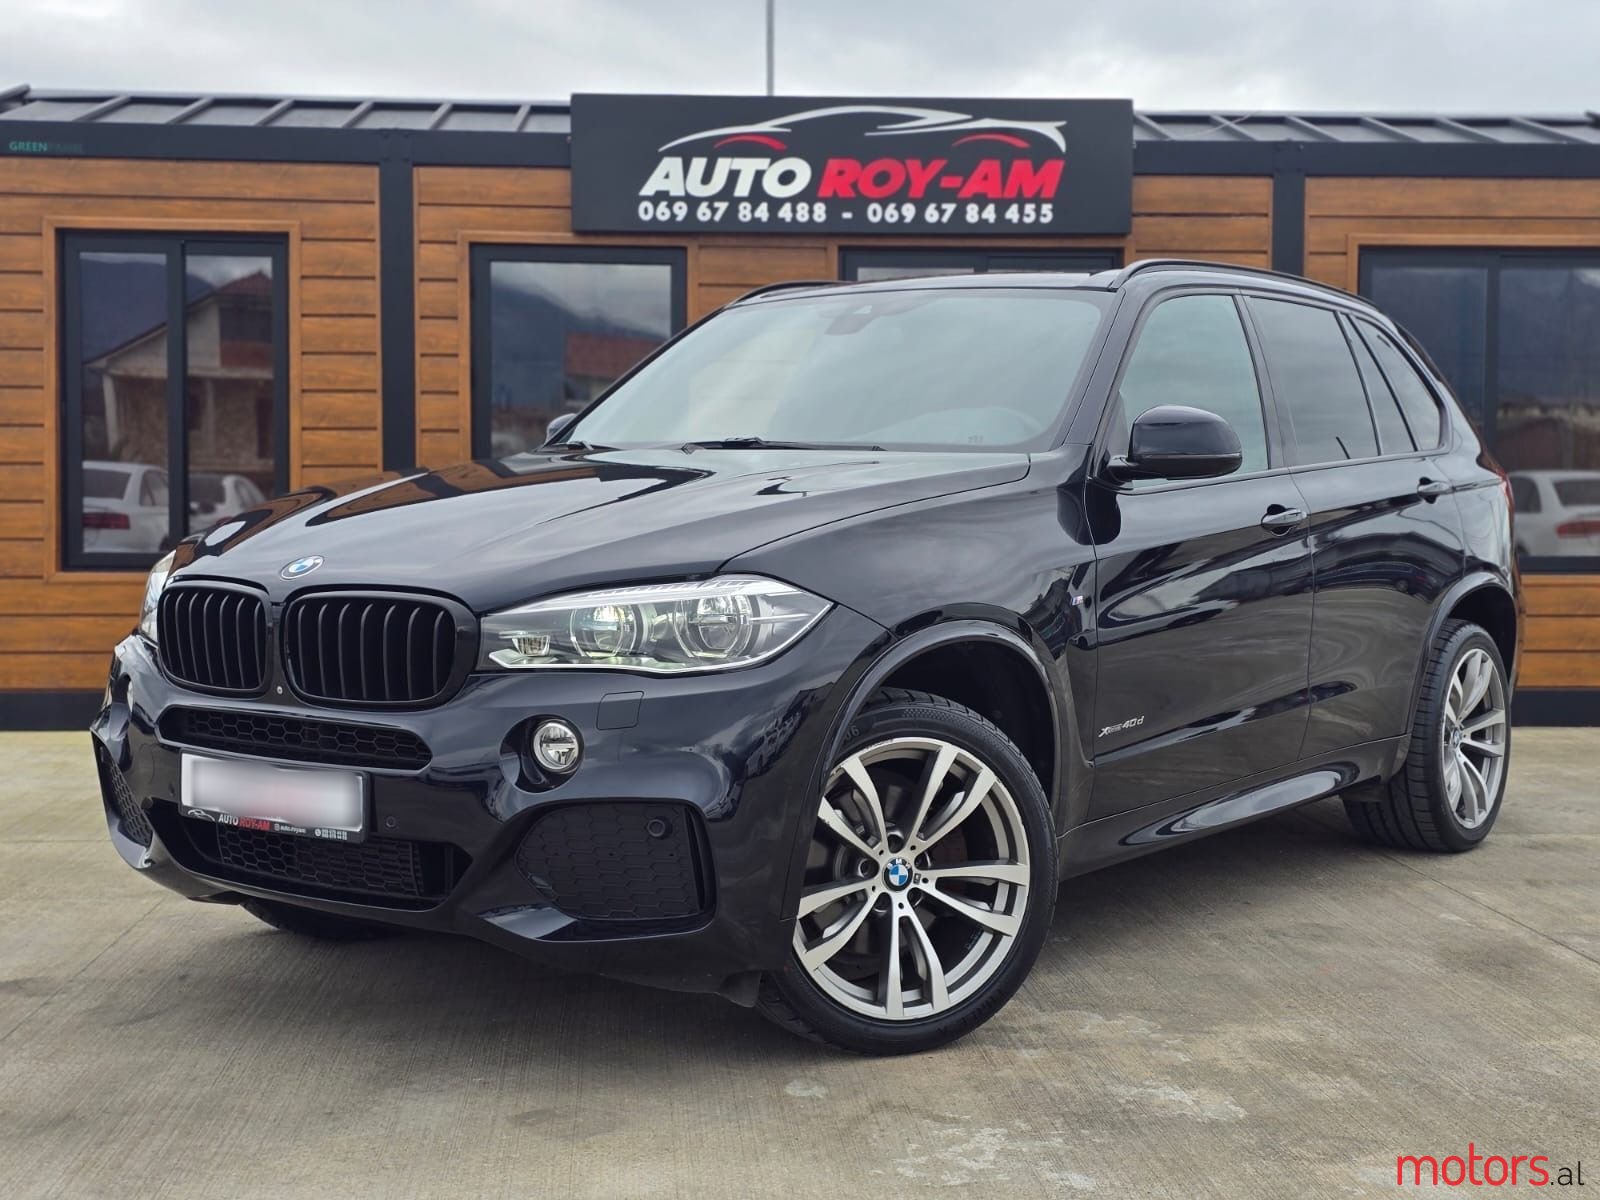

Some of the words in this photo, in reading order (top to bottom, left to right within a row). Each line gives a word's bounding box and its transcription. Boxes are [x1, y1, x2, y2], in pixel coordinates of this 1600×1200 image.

[638, 156, 812, 198] AUTO
[817, 158, 1066, 199] ROY-AM
[637, 201, 689, 222] 069
[696, 202, 730, 222] 67
[737, 202, 770, 223] 84
[777, 202, 827, 223] 488
[866, 202, 916, 224] 069
[924, 202, 957, 224] 67
[965, 203, 997, 224] 84
[1004, 203, 1054, 224] 455
[218, 812, 239, 826] AUTO
